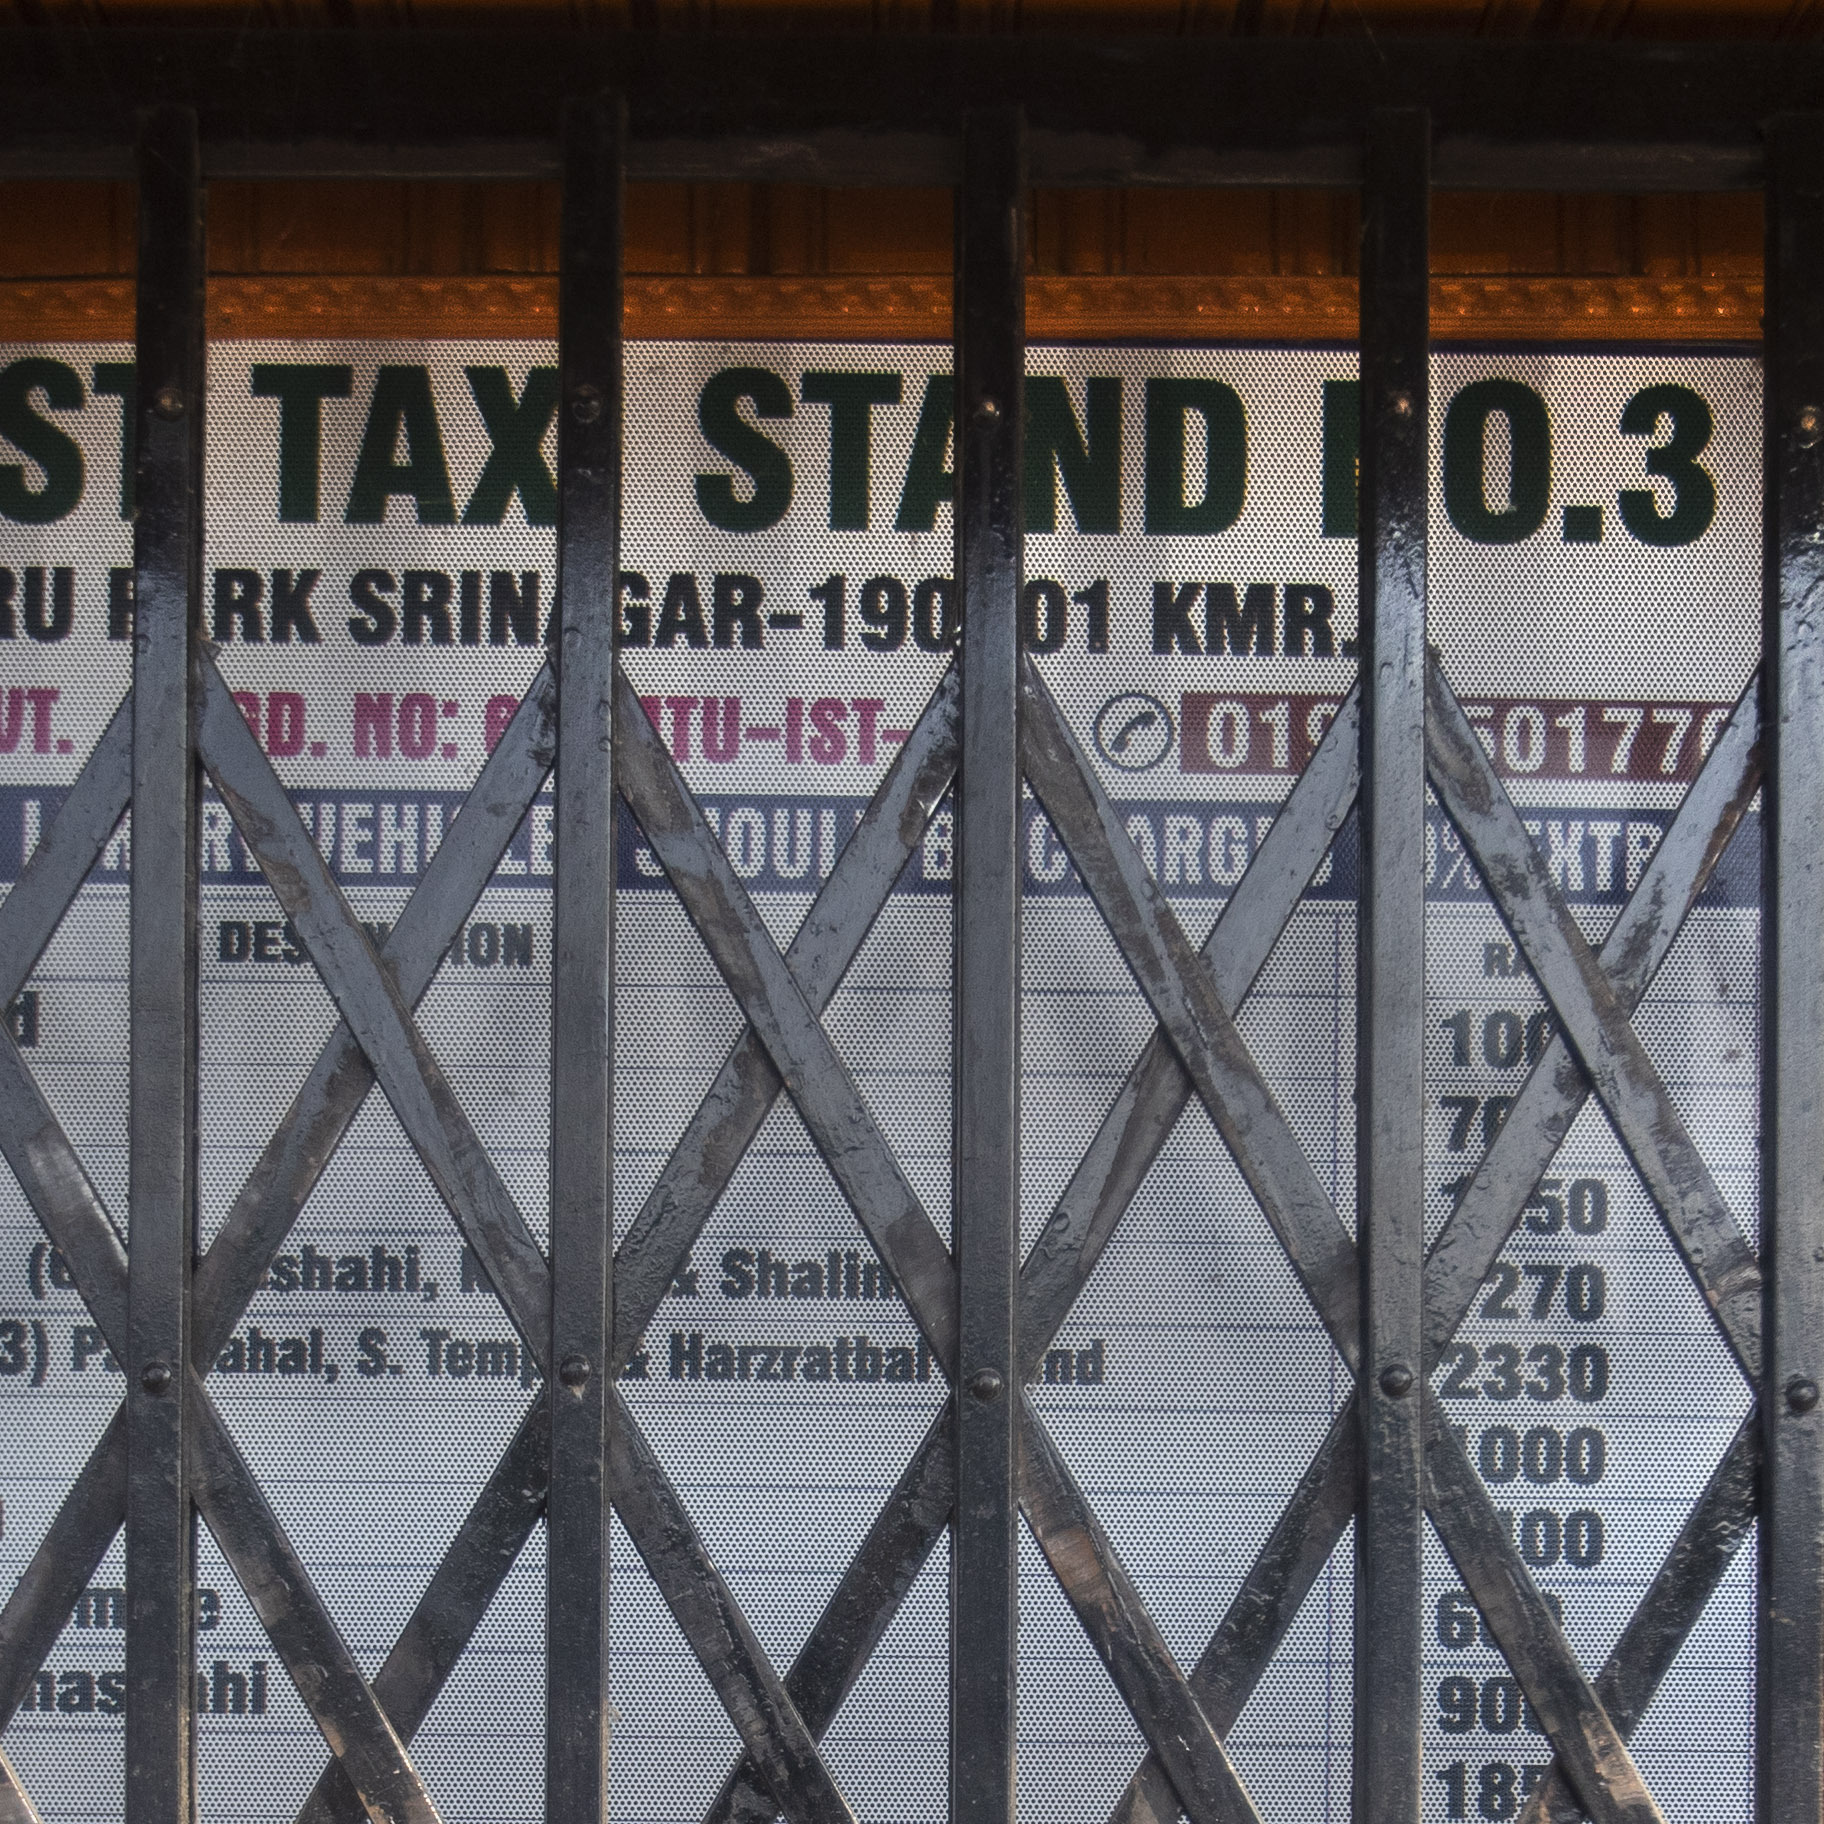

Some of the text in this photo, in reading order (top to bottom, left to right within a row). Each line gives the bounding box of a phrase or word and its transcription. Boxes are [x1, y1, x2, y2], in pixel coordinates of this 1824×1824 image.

[252, 362, 552, 528] TAX
[693, 366, 1250, 538] STAND
[104, 566, 320, 646] PRK
[348, 567, 1108, 655] SRINGAR-19001
[1153, 580, 1357, 658] KMR.
[352, 693, 460, 760] NO:
[355, 1326, 403, 1378] S.
[1437, 1342, 1610, 1401] 2330
[1448, 1424, 1607, 1486] 000
[1436, 1675, 1548, 1736] 90
